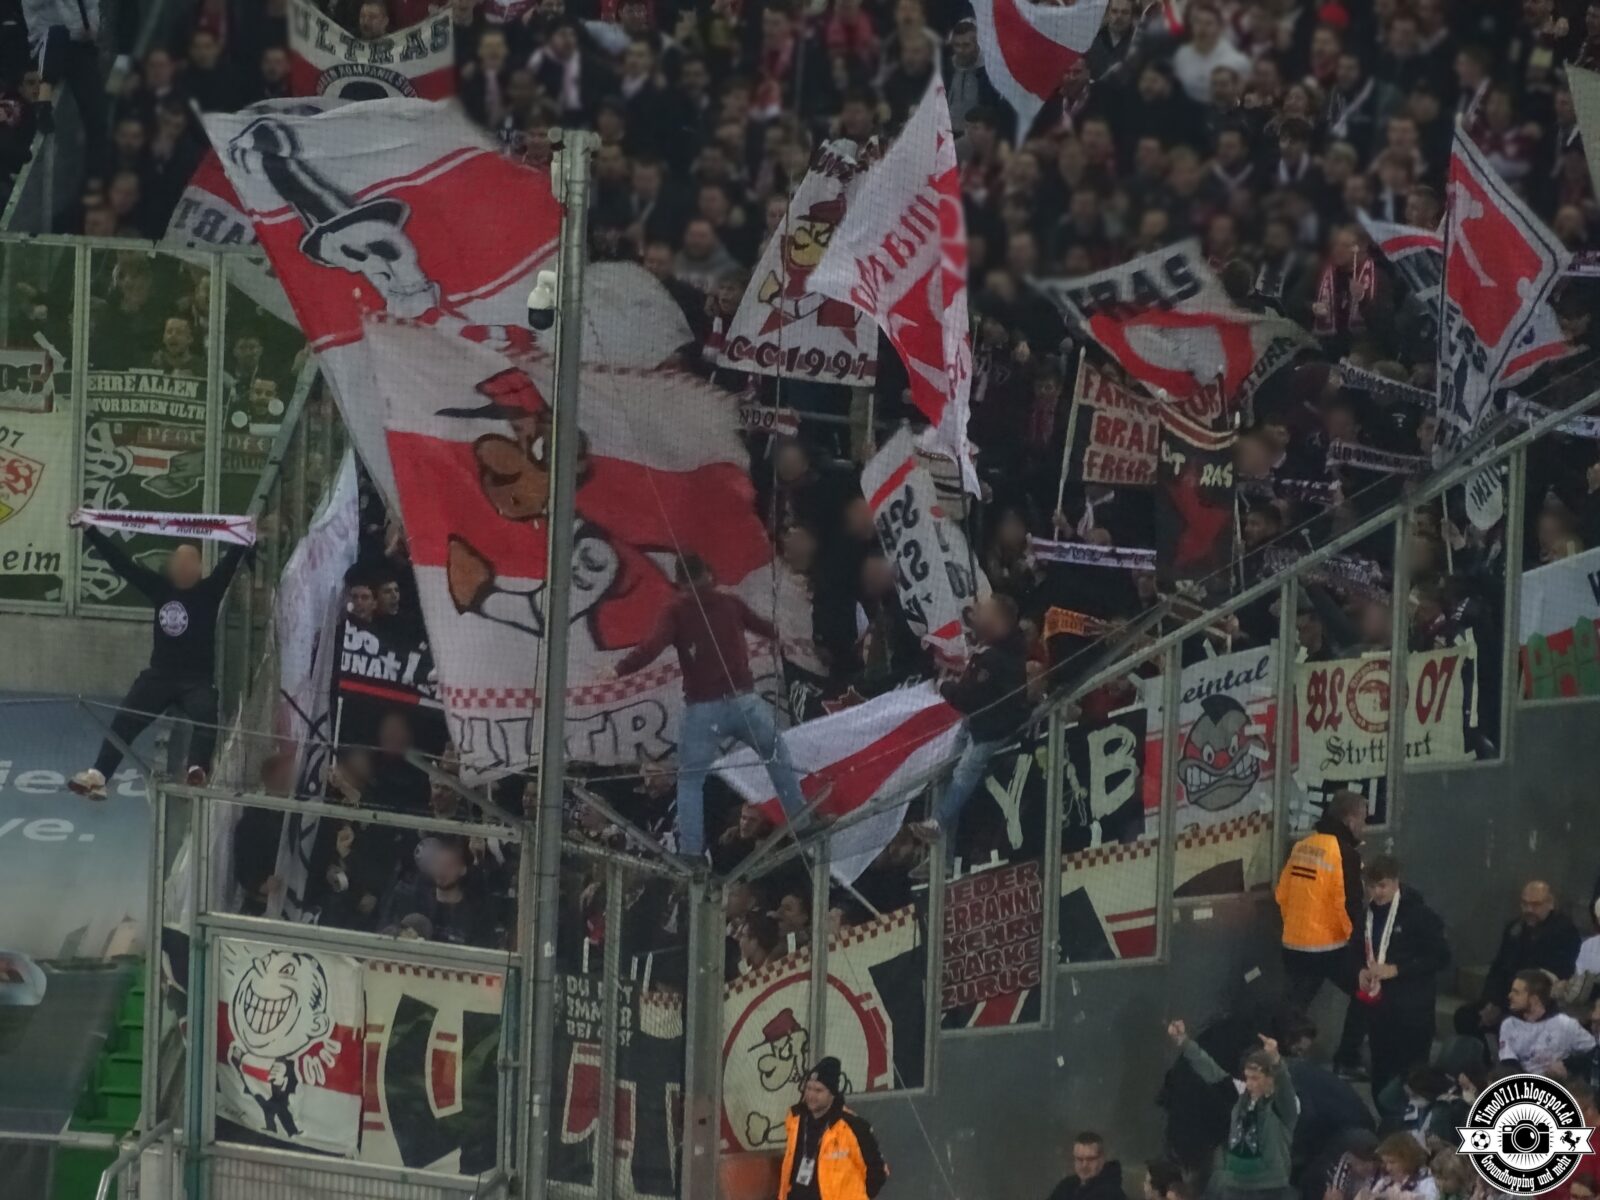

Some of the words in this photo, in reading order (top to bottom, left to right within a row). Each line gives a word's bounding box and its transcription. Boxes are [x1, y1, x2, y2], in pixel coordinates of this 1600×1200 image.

[294, 8, 452, 64] ULTRAS
[174, 198, 250, 245] TRA
[88, 374, 136, 393] EHRE
[139, 375, 199, 399] ALLEN
[90, 397, 167, 416] TORBENEN
[170, 402, 207, 421] ULTR
[1180, 655, 1270, 704] eintal
[566, 976, 590, 998] DU
[566, 995, 632, 1028] IMMR
[566, 1020, 593, 1040] BEI
